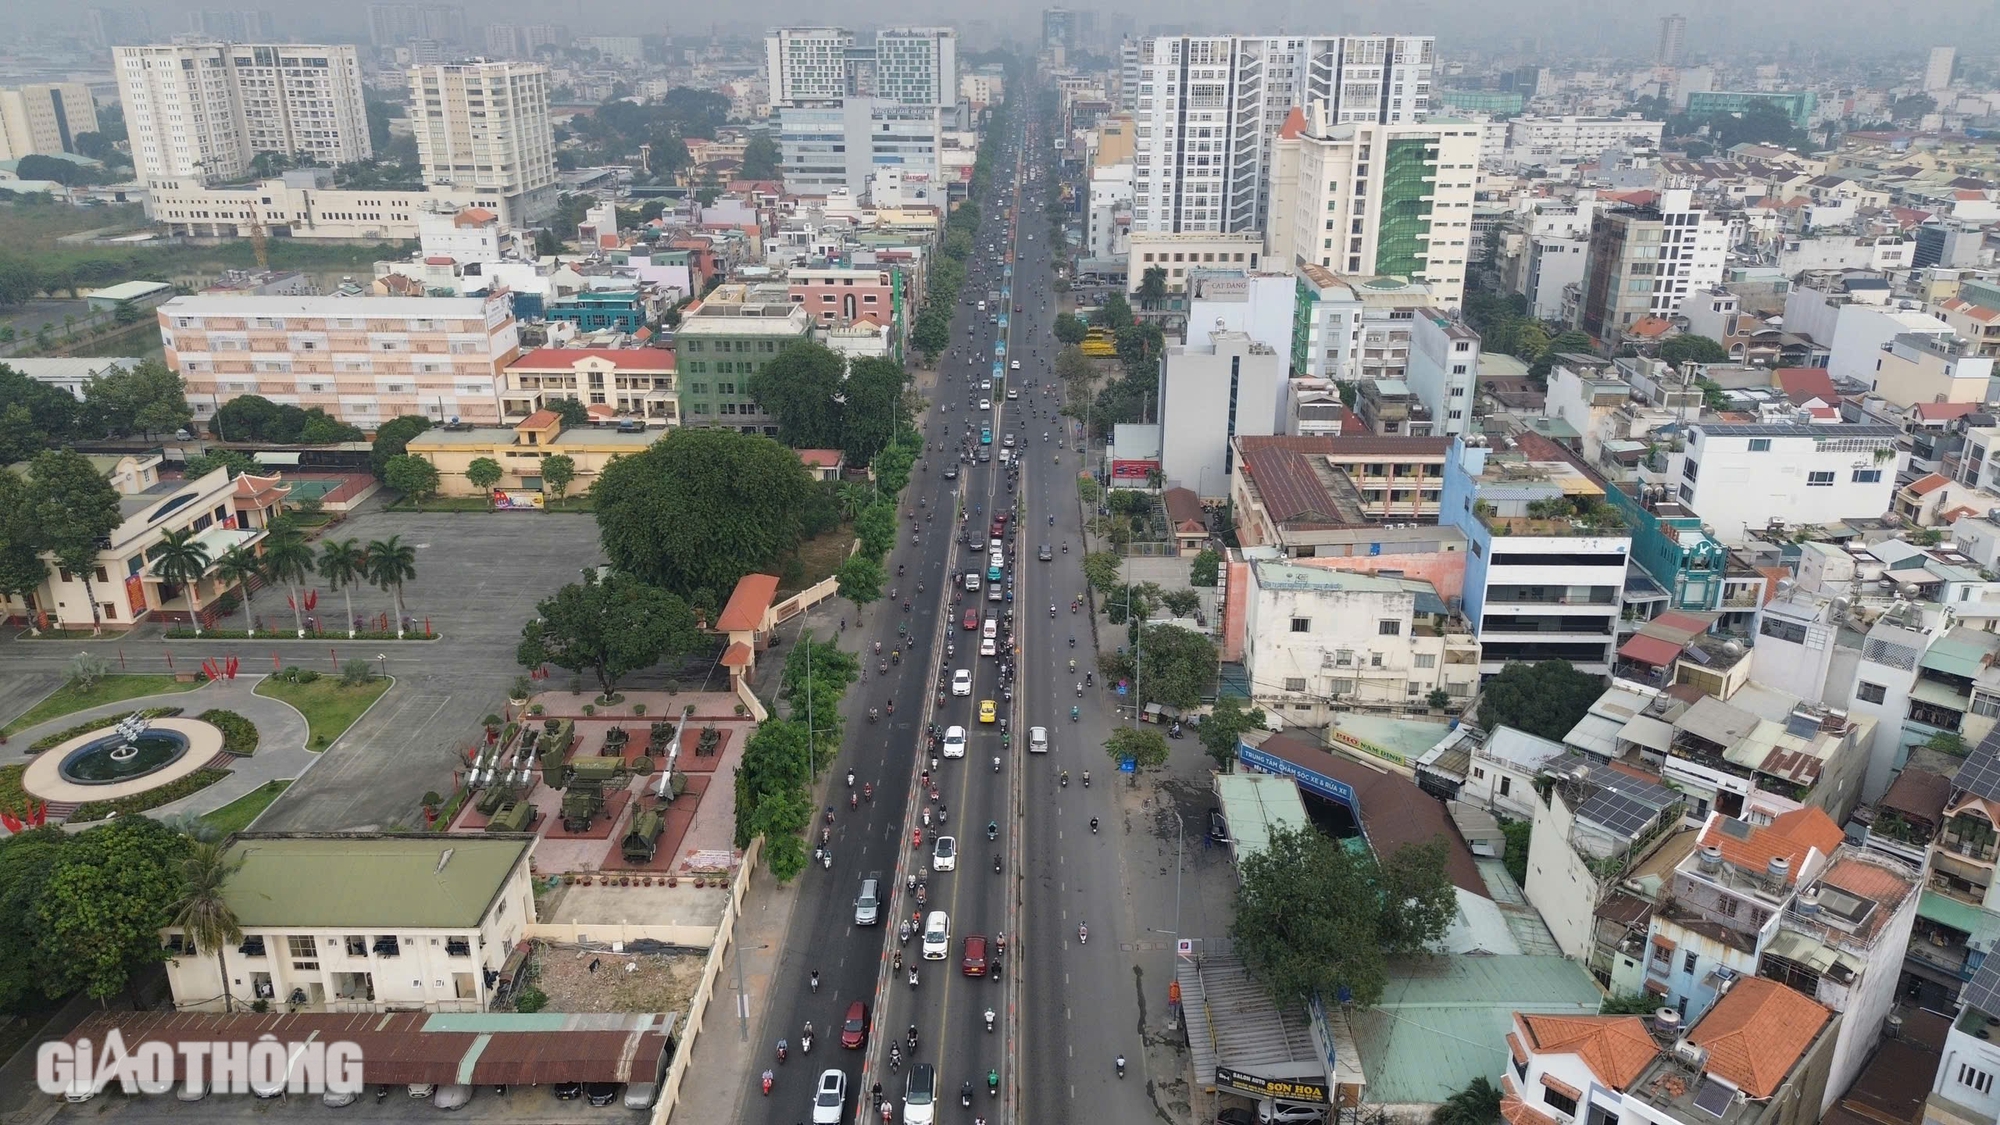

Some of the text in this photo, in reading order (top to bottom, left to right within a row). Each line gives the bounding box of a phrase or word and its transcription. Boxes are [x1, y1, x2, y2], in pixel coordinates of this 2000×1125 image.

[1360, 741, 1380, 753] NAM
[1245, 751, 1264, 763] TRUNG
[1266, 759, 1278, 768] TÂM
[1297, 769, 1310, 781] SÓC
[1310, 775, 1319, 784] XE
[1338, 786, 1348, 796] XE
[1233, 1072, 1251, 1081] SALON
[1266, 1082, 1292, 1092] SƠN
[1295, 1085, 1322, 1095] HOA
